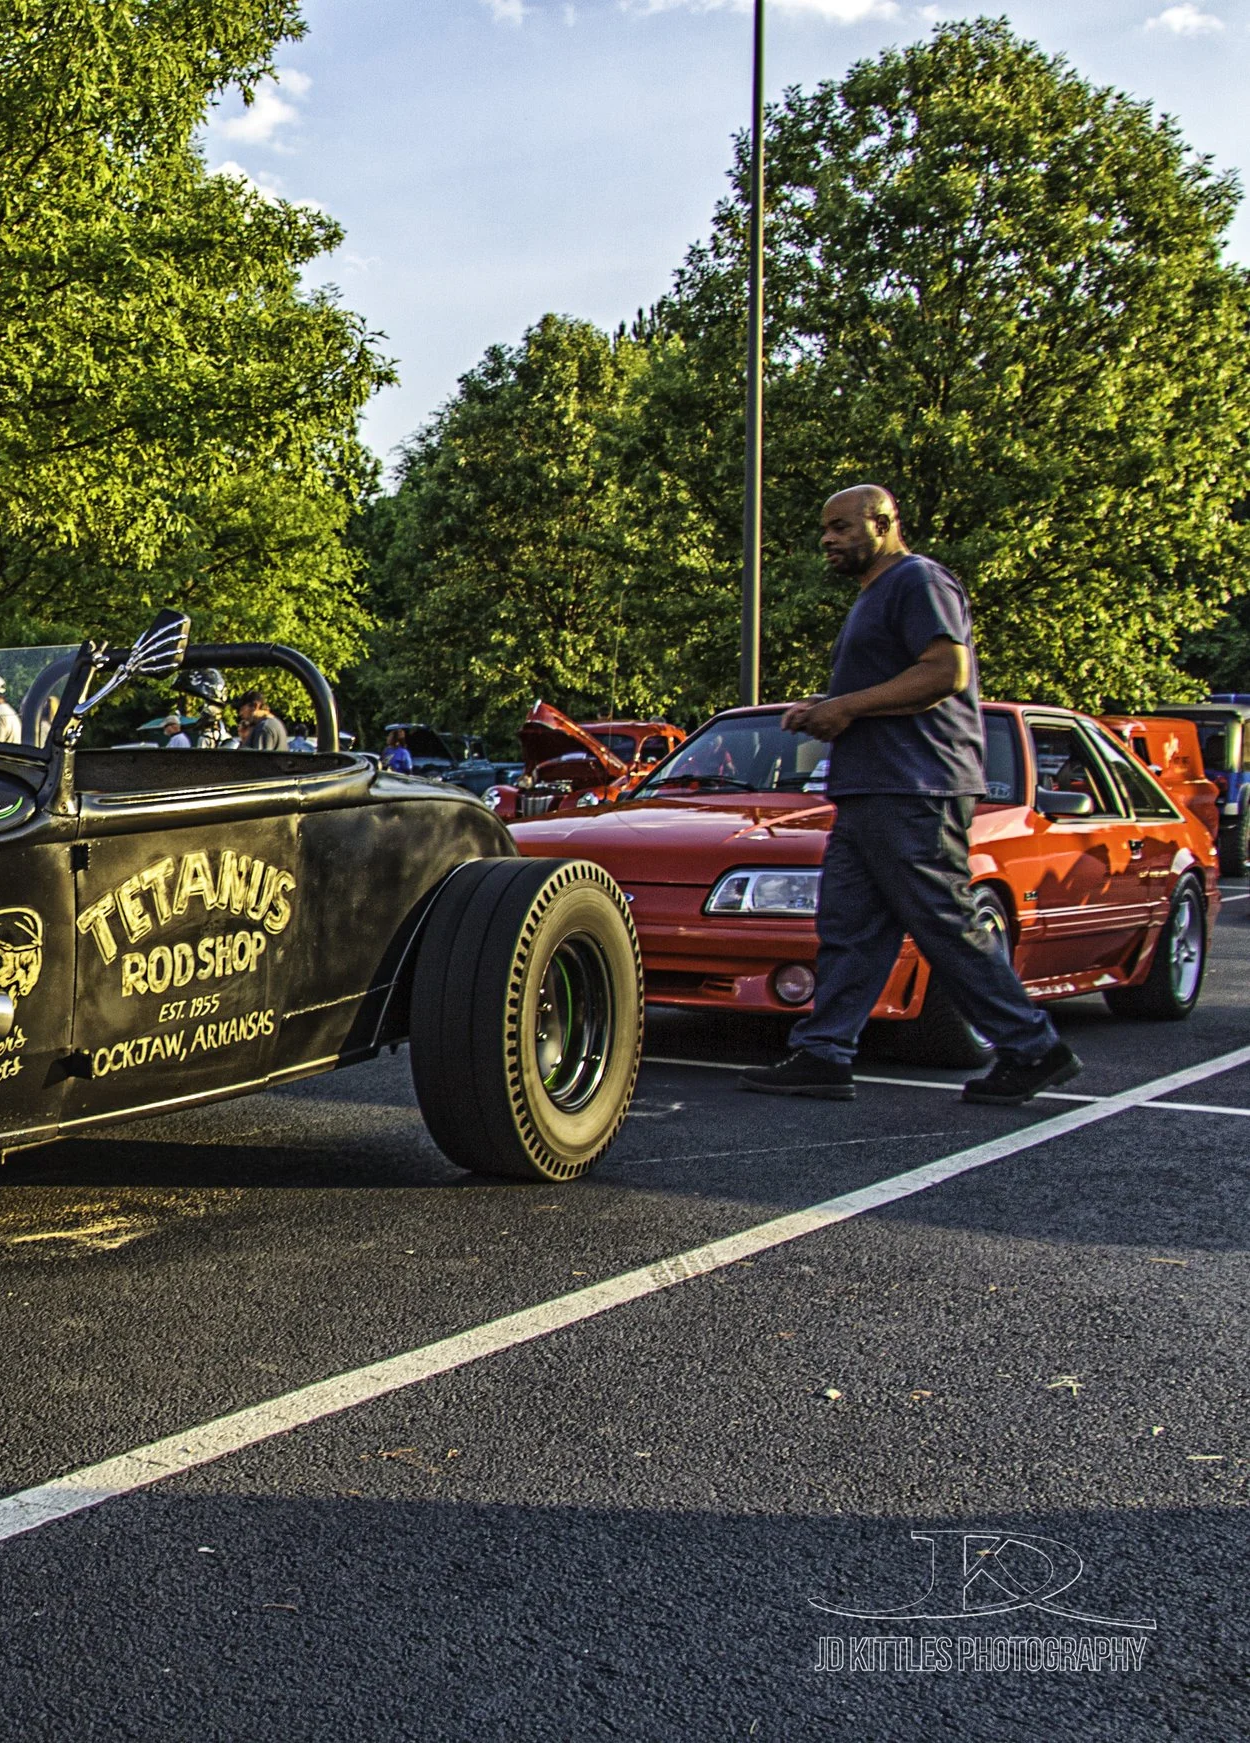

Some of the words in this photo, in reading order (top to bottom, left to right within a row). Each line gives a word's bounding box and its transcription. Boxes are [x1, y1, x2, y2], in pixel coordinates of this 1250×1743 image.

[76, 849, 296, 965] TETANUS
[121, 942, 195, 997] ROD
[196, 930, 267, 981] SHOP
[158, 999, 185, 1023] EST.
[188, 993, 221, 1019] 1955
[83, 1030, 188, 1077] OCKJAW,
[190, 1008, 275, 1053] ARKANSAS
